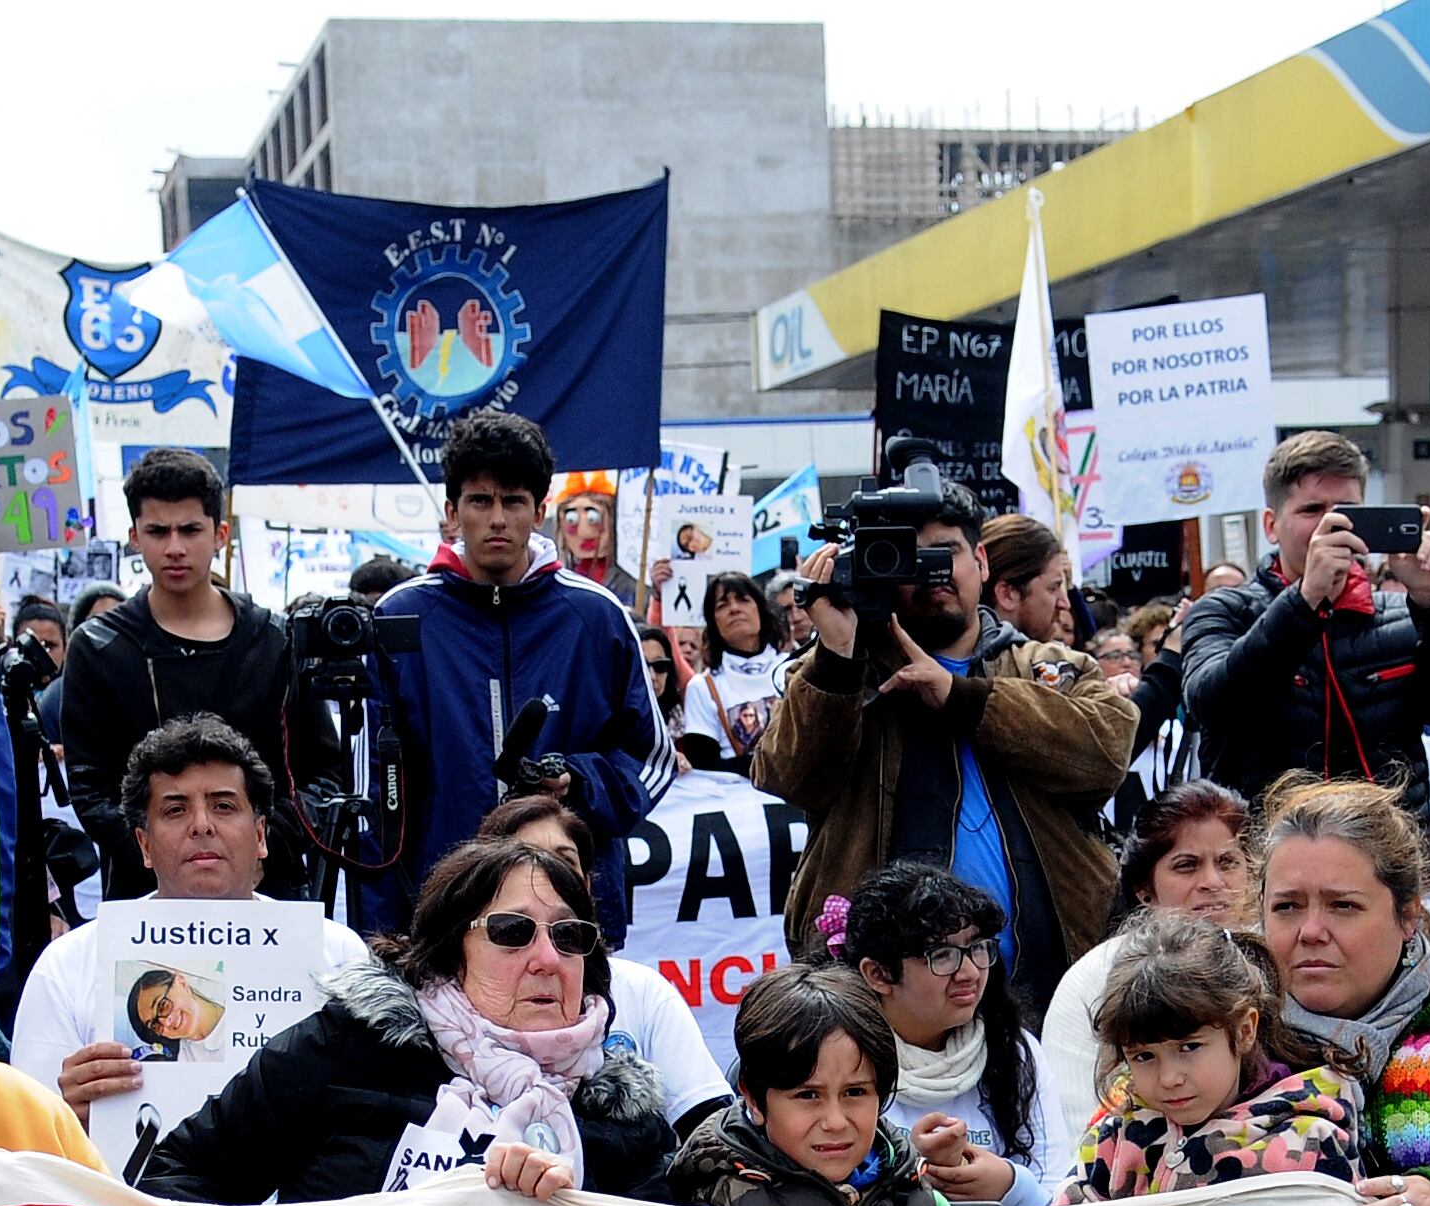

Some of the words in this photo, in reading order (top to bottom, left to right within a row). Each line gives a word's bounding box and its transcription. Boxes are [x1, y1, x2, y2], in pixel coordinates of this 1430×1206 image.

[1132, 326, 1168, 342] POR
[1173, 318, 1224, 338] ELLOS
[1112, 358, 1148, 376] POR
[1153, 346, 1249, 370] NOSOTROS
[895, 368, 975, 405] MARÍA
[1118, 388, 1154, 406] POR
[1159, 386, 1180, 402] LA
[1185, 378, 1248, 398] PATRIA
[677, 503, 725, 515] Justicia
[387, 764, 399, 811] Canon
[131, 921, 251, 945] Justicia
[262, 927, 280, 946] x
[232, 985, 302, 1002] Sandra
[255, 1013, 266, 1029] y
